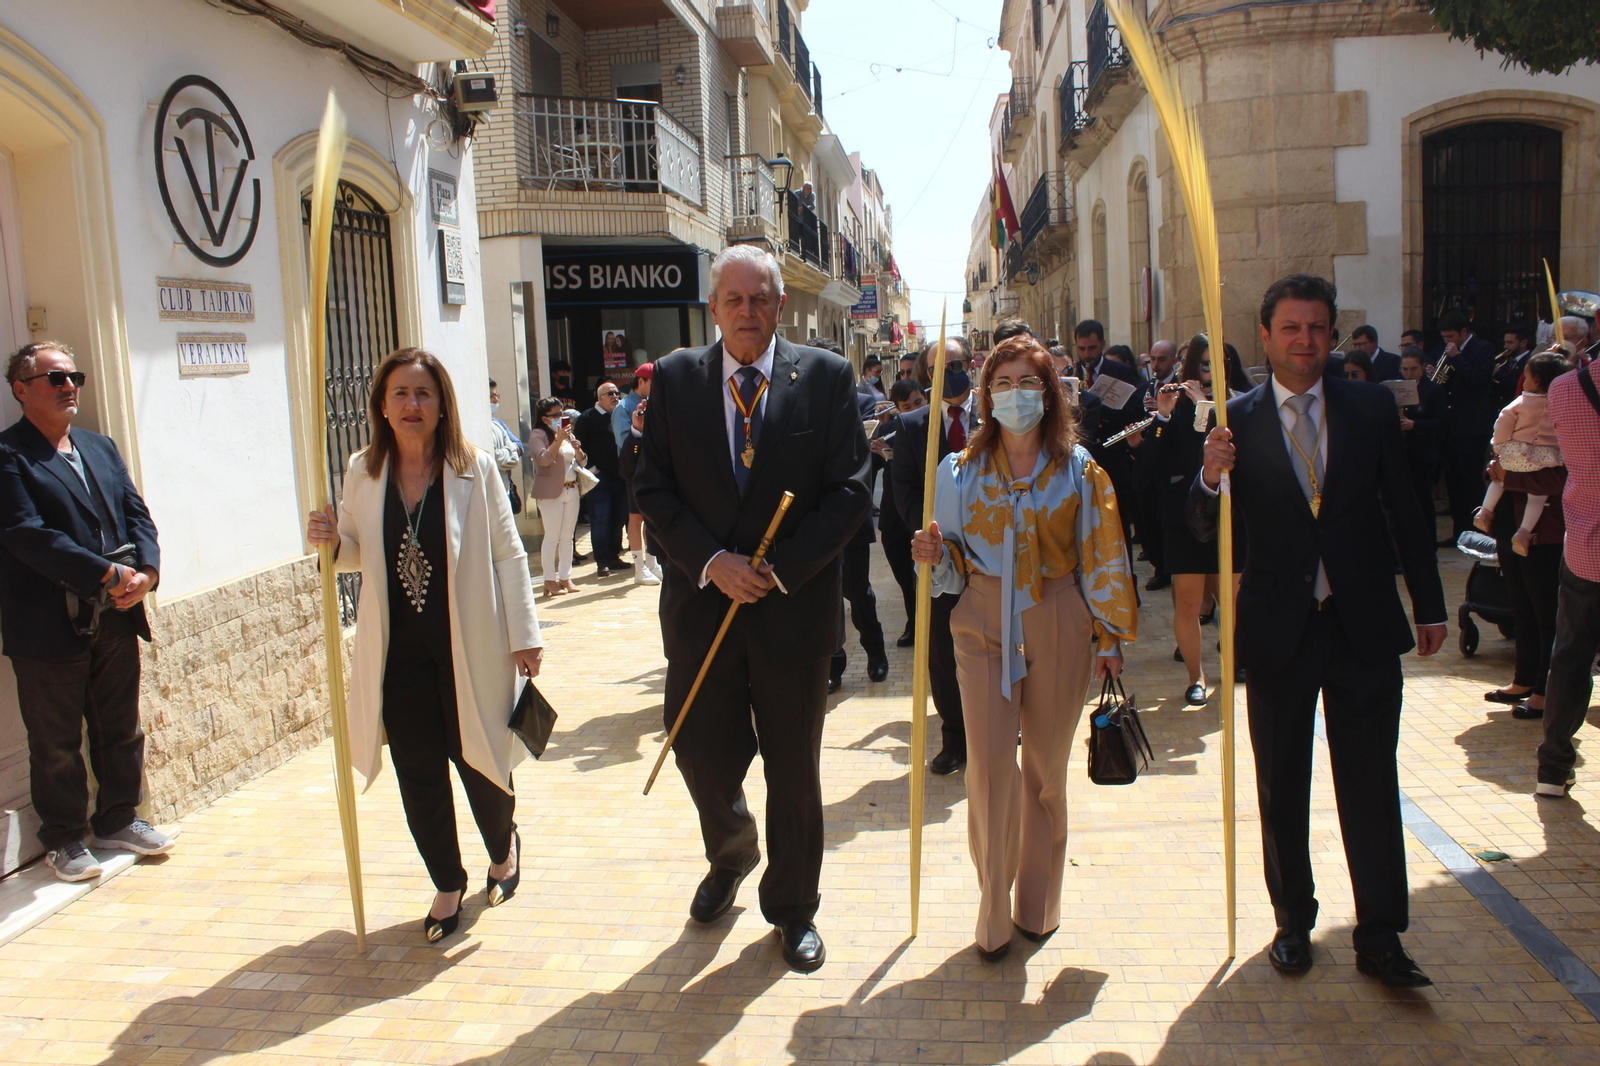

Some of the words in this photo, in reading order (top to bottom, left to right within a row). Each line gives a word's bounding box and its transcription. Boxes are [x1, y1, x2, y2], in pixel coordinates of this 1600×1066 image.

[436, 182, 451, 200] Plaza
[589, 264, 682, 290] BIANKO
[160, 287, 192, 311] CLUB
[200, 290, 253, 314] TAURINO
[180, 342, 248, 365] VERATENSE
